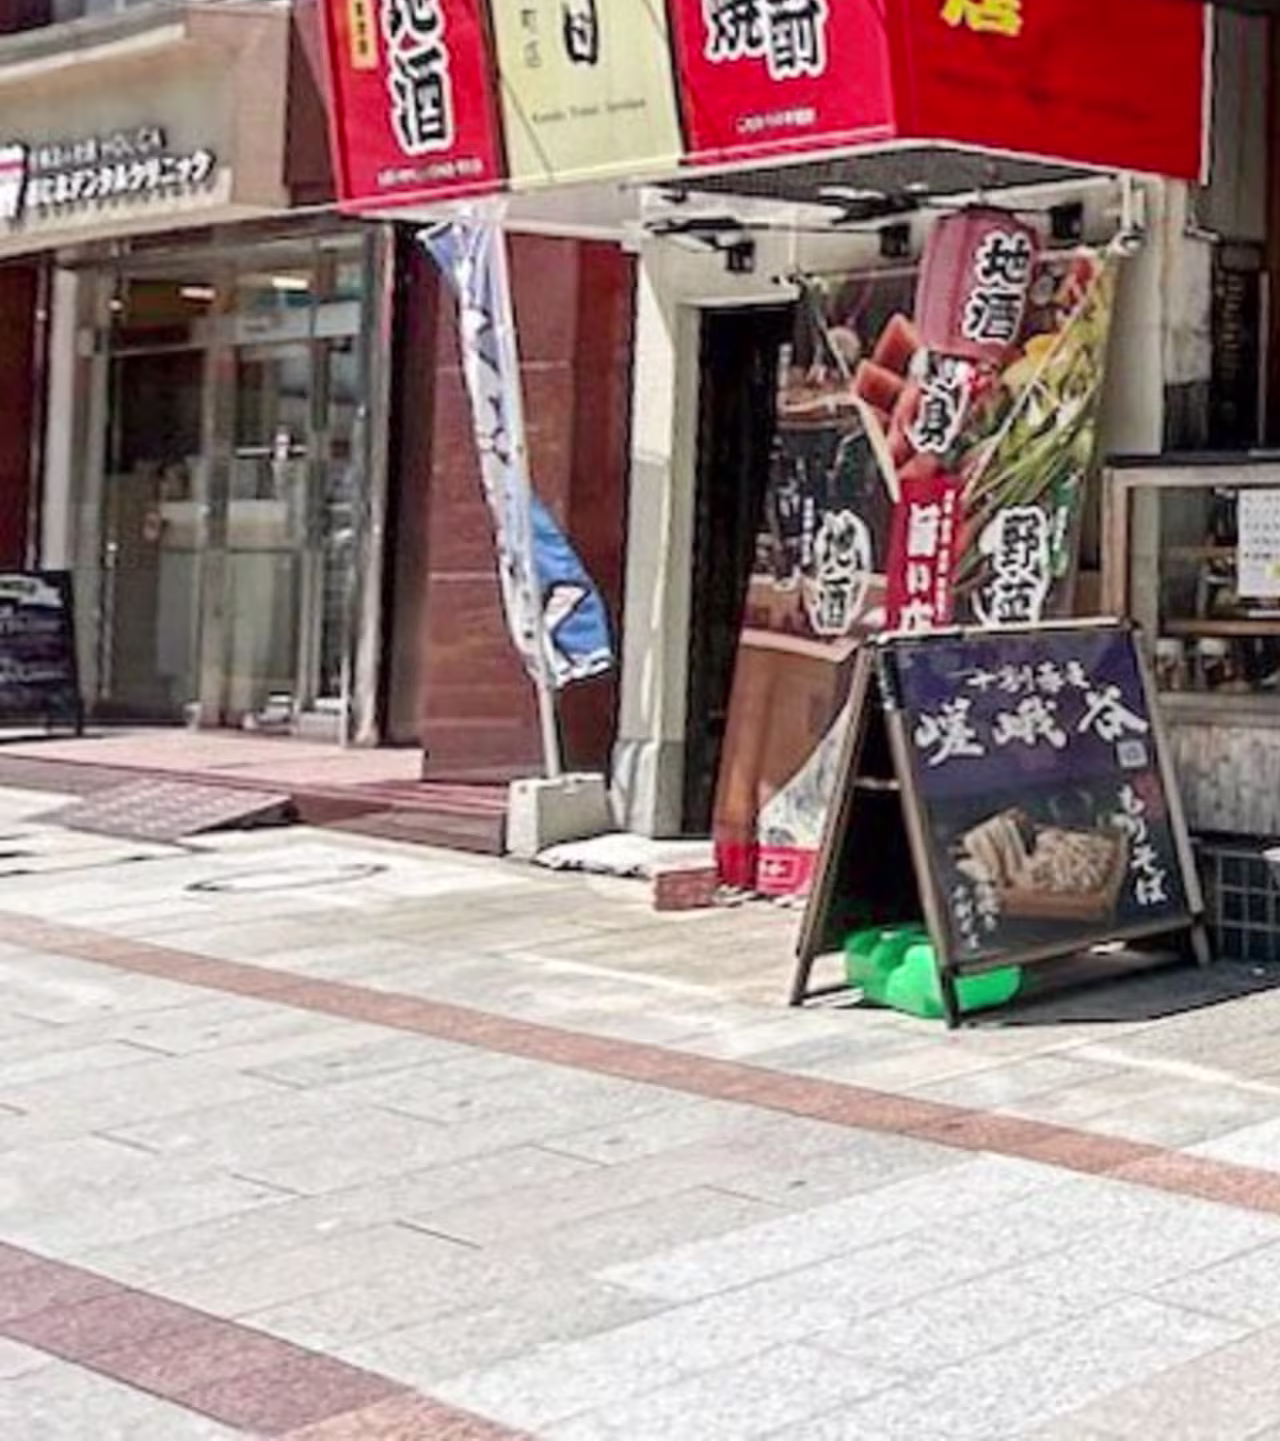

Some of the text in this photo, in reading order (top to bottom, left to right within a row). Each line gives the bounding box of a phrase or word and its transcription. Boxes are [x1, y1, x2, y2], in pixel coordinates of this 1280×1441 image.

[961, 231, 1033, 345] 地酒
[915, 686, 1149, 766] 嵯峨谷
